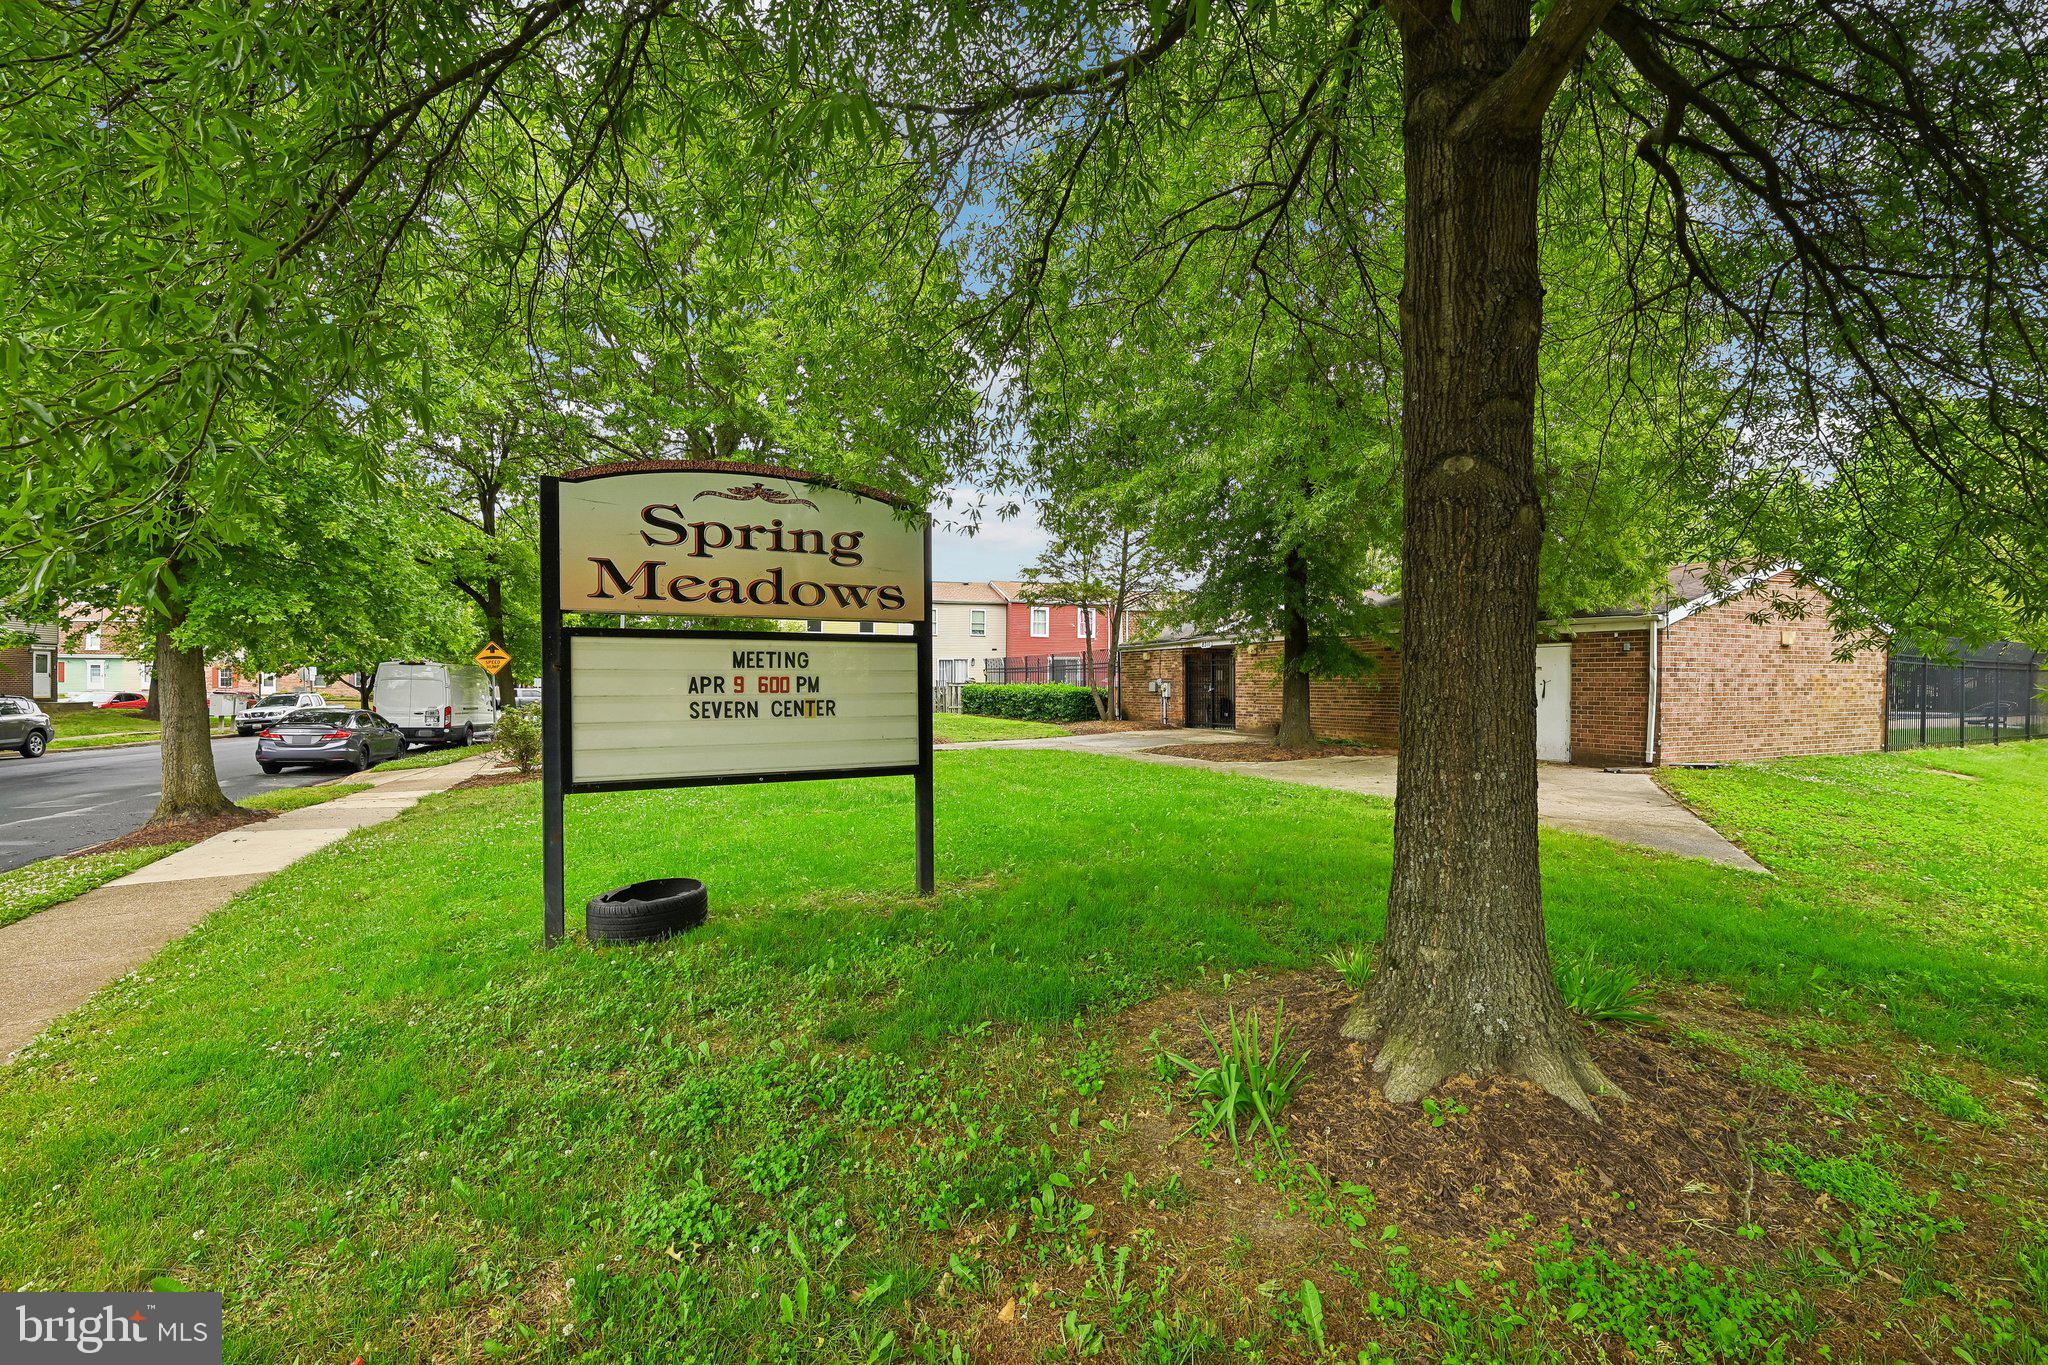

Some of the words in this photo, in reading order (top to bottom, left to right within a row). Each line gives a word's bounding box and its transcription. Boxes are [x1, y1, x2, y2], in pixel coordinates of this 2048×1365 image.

[640, 504, 865, 566] Spring
[587, 557, 907, 611] Meadows
[732, 650, 810, 669] MEETING
[688, 676, 725, 694] APR
[733, 676, 745, 694] 9
[758, 676, 790, 694] 600
[796, 676, 820, 693] PM
[689, 700, 759, 719] SEVERN
[771, 699, 836, 718] CENTER
